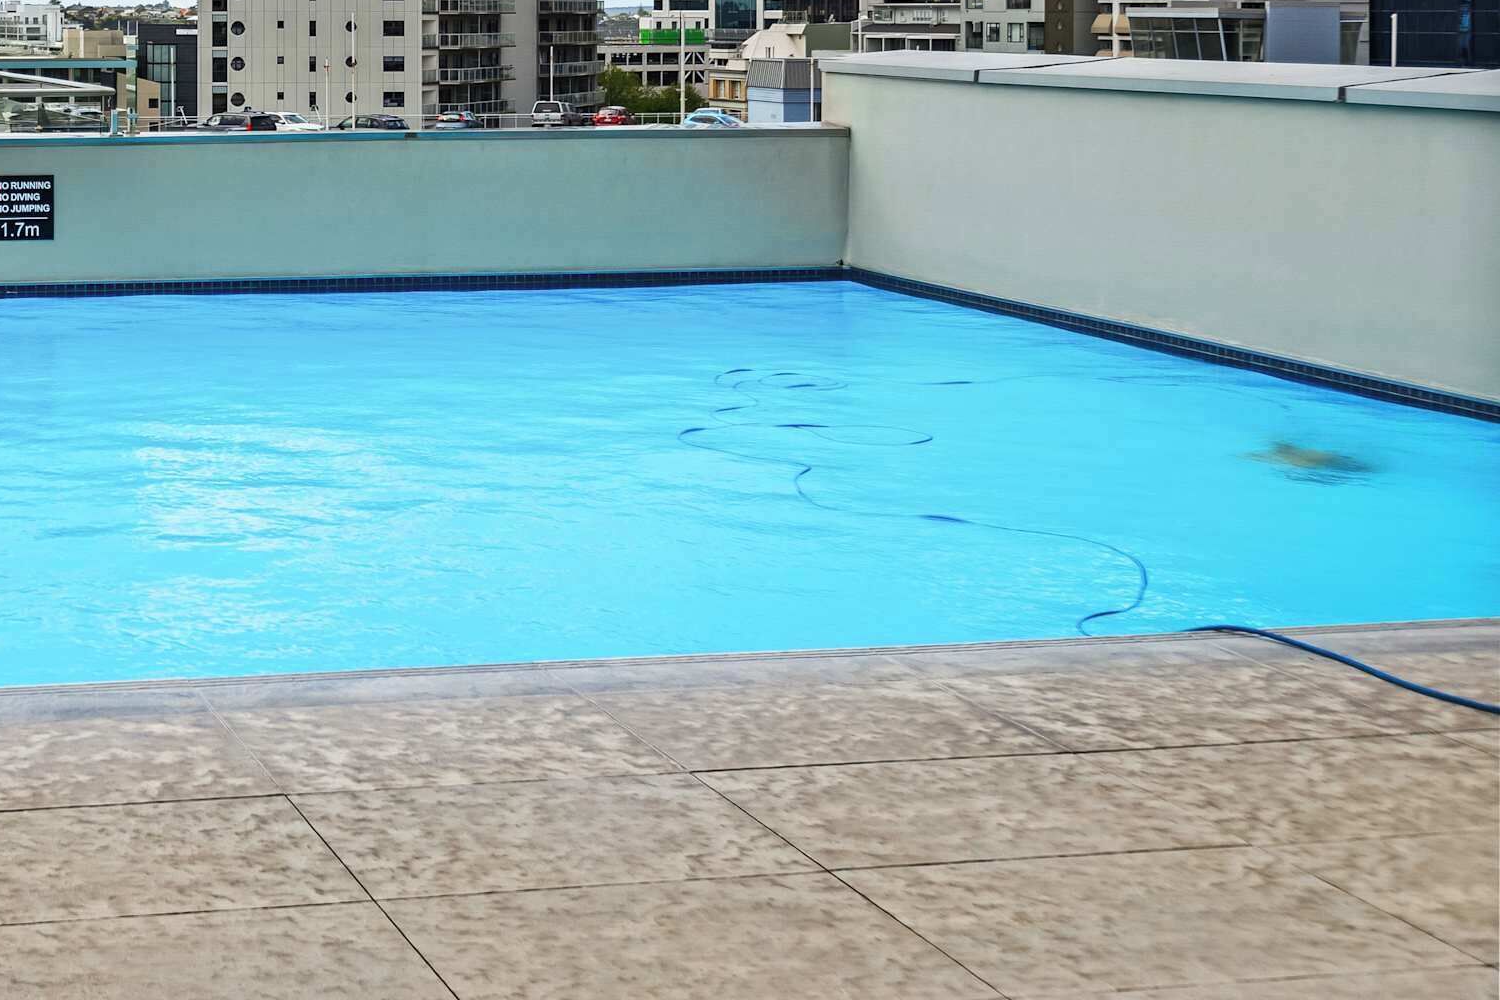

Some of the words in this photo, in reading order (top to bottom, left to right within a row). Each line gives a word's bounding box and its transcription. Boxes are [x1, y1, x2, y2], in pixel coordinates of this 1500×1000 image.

[10, 181, 51, 190] RUNNING
[10, 192, 41, 201] DIVING
[10, 203, 50, 213] JUMPING
[0, 222, 40, 237] 1.7m
